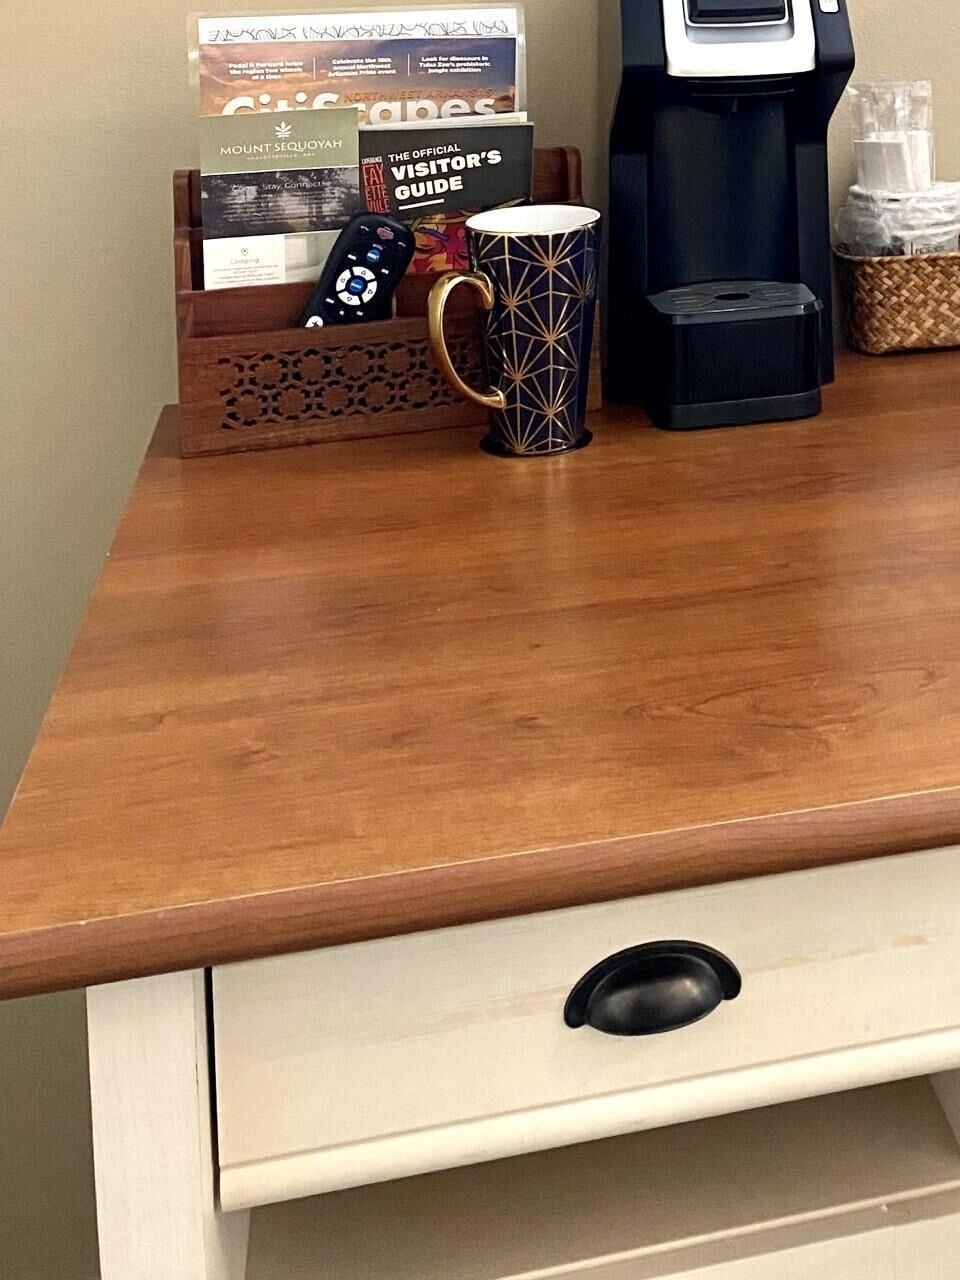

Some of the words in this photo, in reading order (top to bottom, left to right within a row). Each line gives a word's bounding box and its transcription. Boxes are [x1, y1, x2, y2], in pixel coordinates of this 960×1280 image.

[220, 143, 272, 155] MOUNT
[274, 139, 343, 152] SEQUOYAH
[388, 151, 410, 163] THE
[413, 144, 461, 159] OFFICIAL
[390, 149, 502, 181] VISITOR'S
[394, 175, 464, 200] GUIDE
